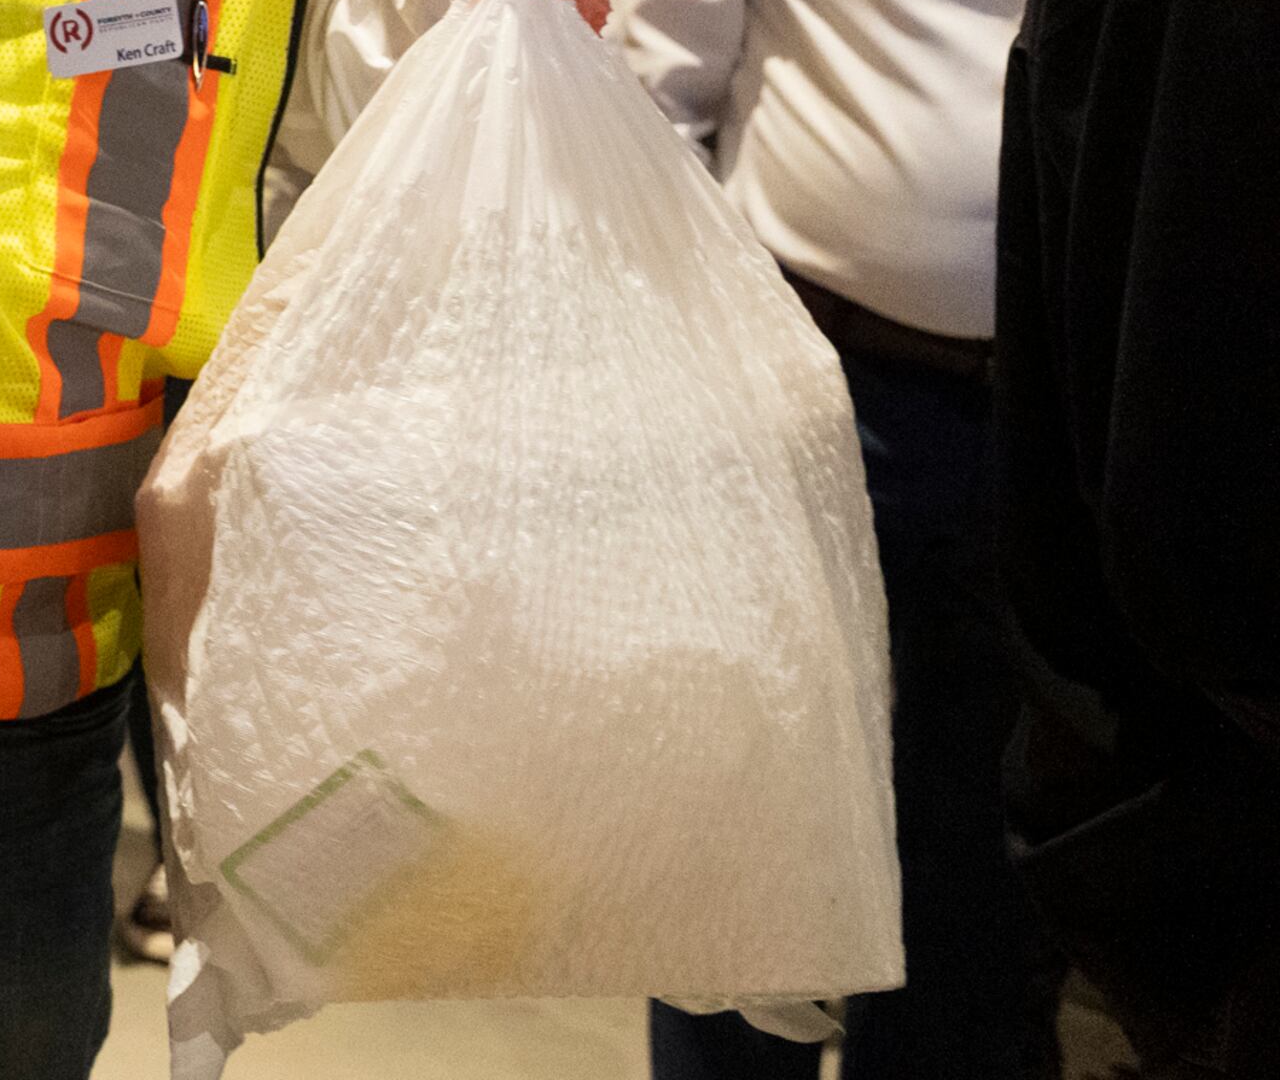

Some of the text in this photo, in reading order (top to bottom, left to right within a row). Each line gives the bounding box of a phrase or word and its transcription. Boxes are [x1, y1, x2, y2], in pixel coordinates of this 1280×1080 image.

[141, 7, 171, 17] COUNTY
[116, 40, 176, 62] Ken Craft
